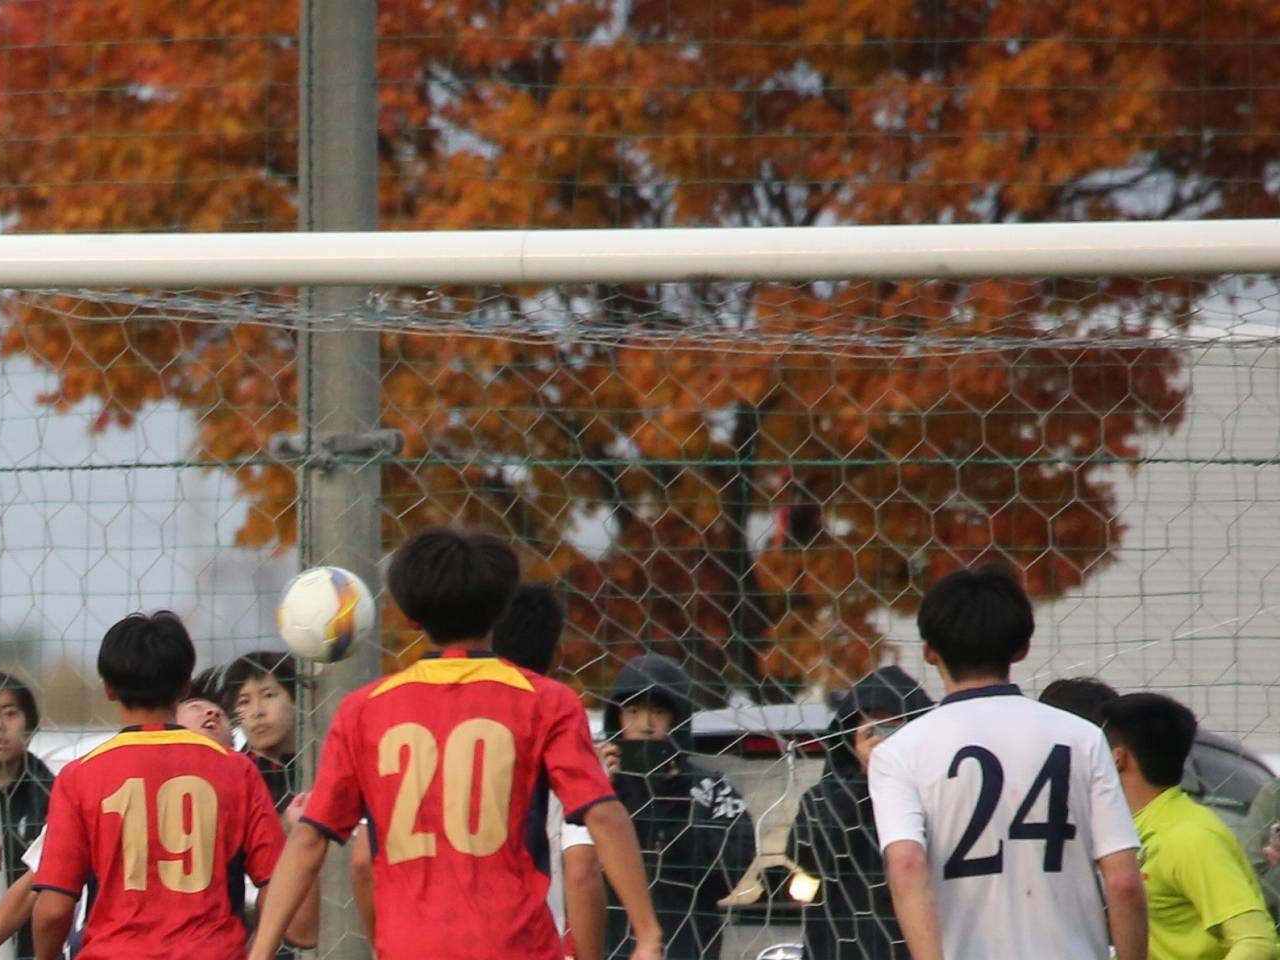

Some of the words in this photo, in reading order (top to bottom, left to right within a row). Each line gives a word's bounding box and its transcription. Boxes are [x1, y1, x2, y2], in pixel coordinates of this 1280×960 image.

[101, 775, 218, 893] 19
[378, 718, 516, 864] 20
[943, 744, 1077, 880] 24
